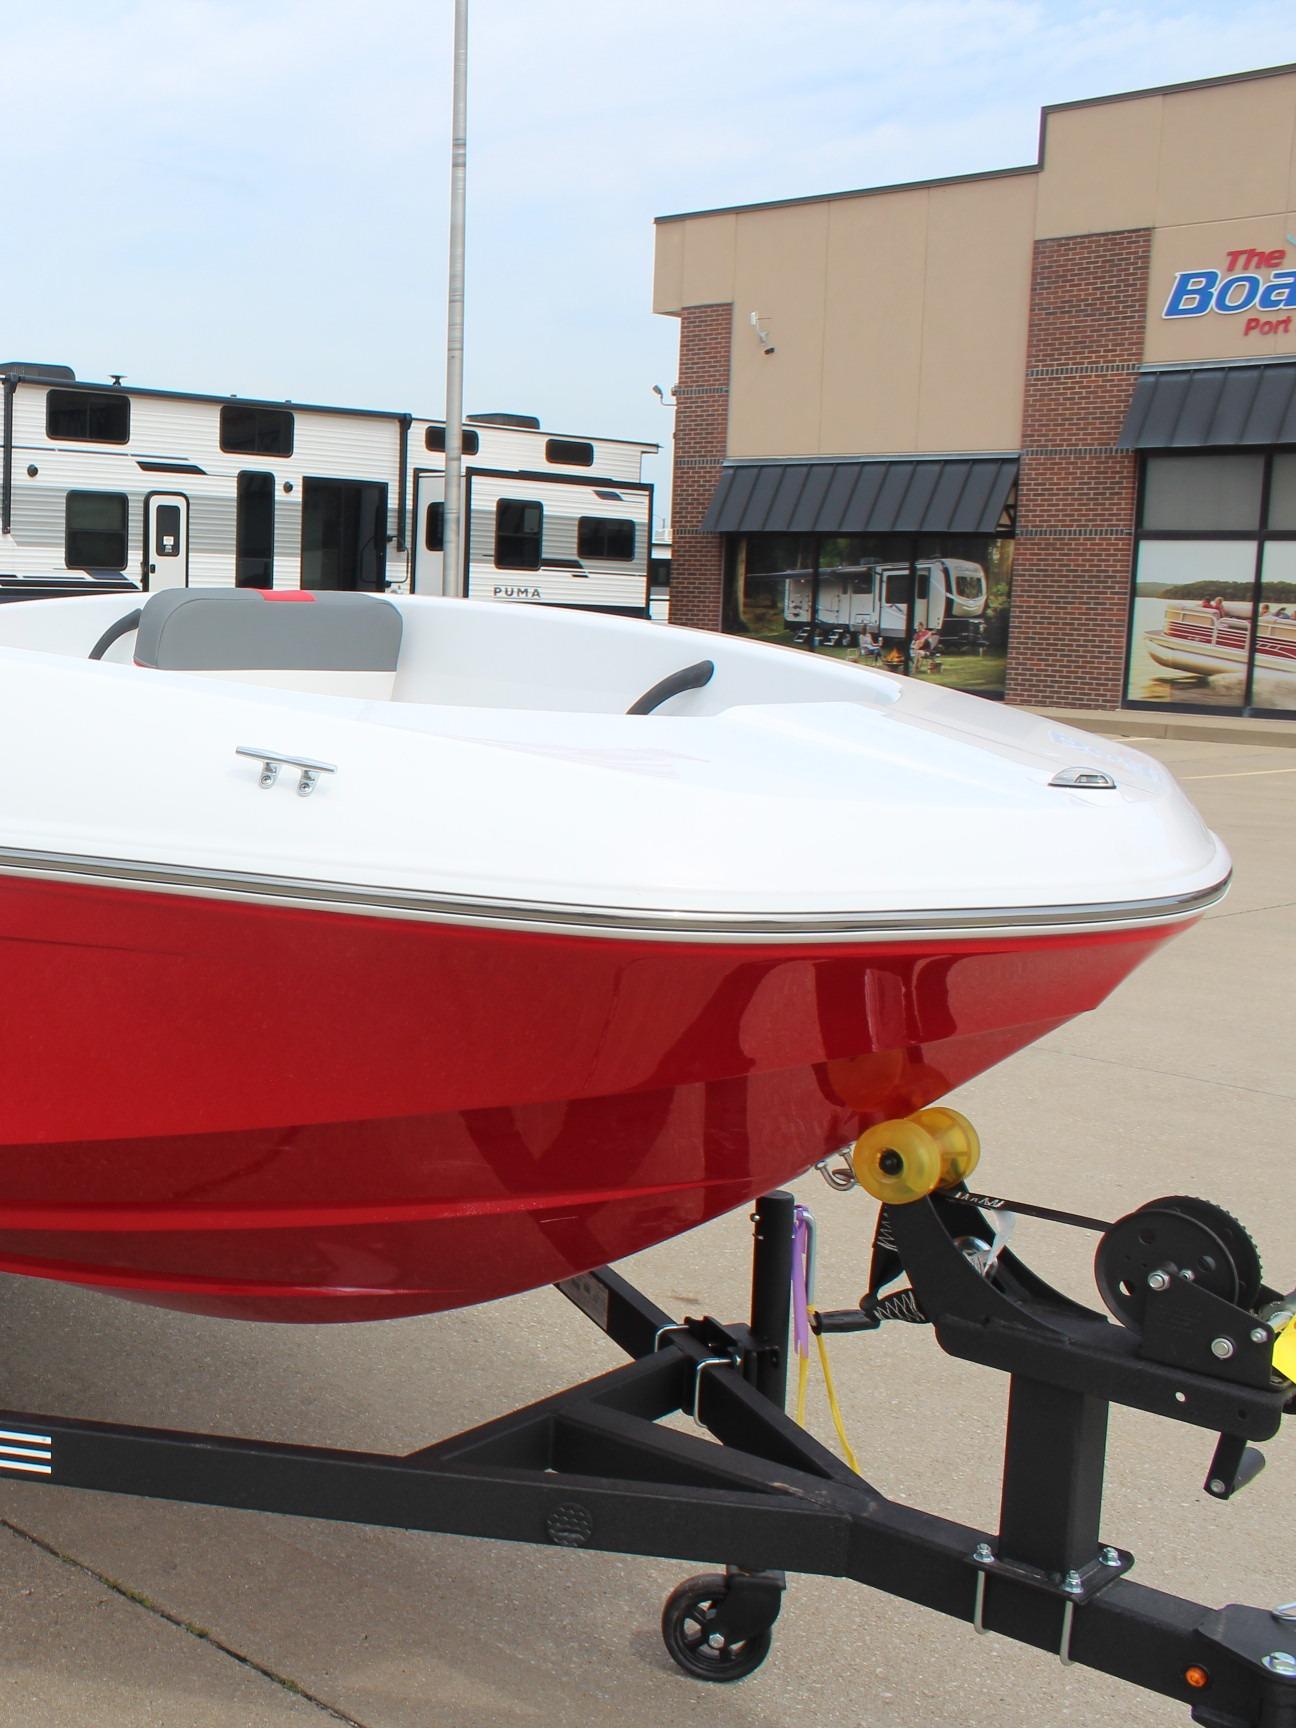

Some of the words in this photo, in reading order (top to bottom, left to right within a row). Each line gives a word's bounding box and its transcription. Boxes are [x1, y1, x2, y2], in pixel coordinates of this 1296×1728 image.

[1226, 247, 1287, 272] The
[1243, 315, 1292, 337] Port
[493, 586, 542, 599] PUMA
